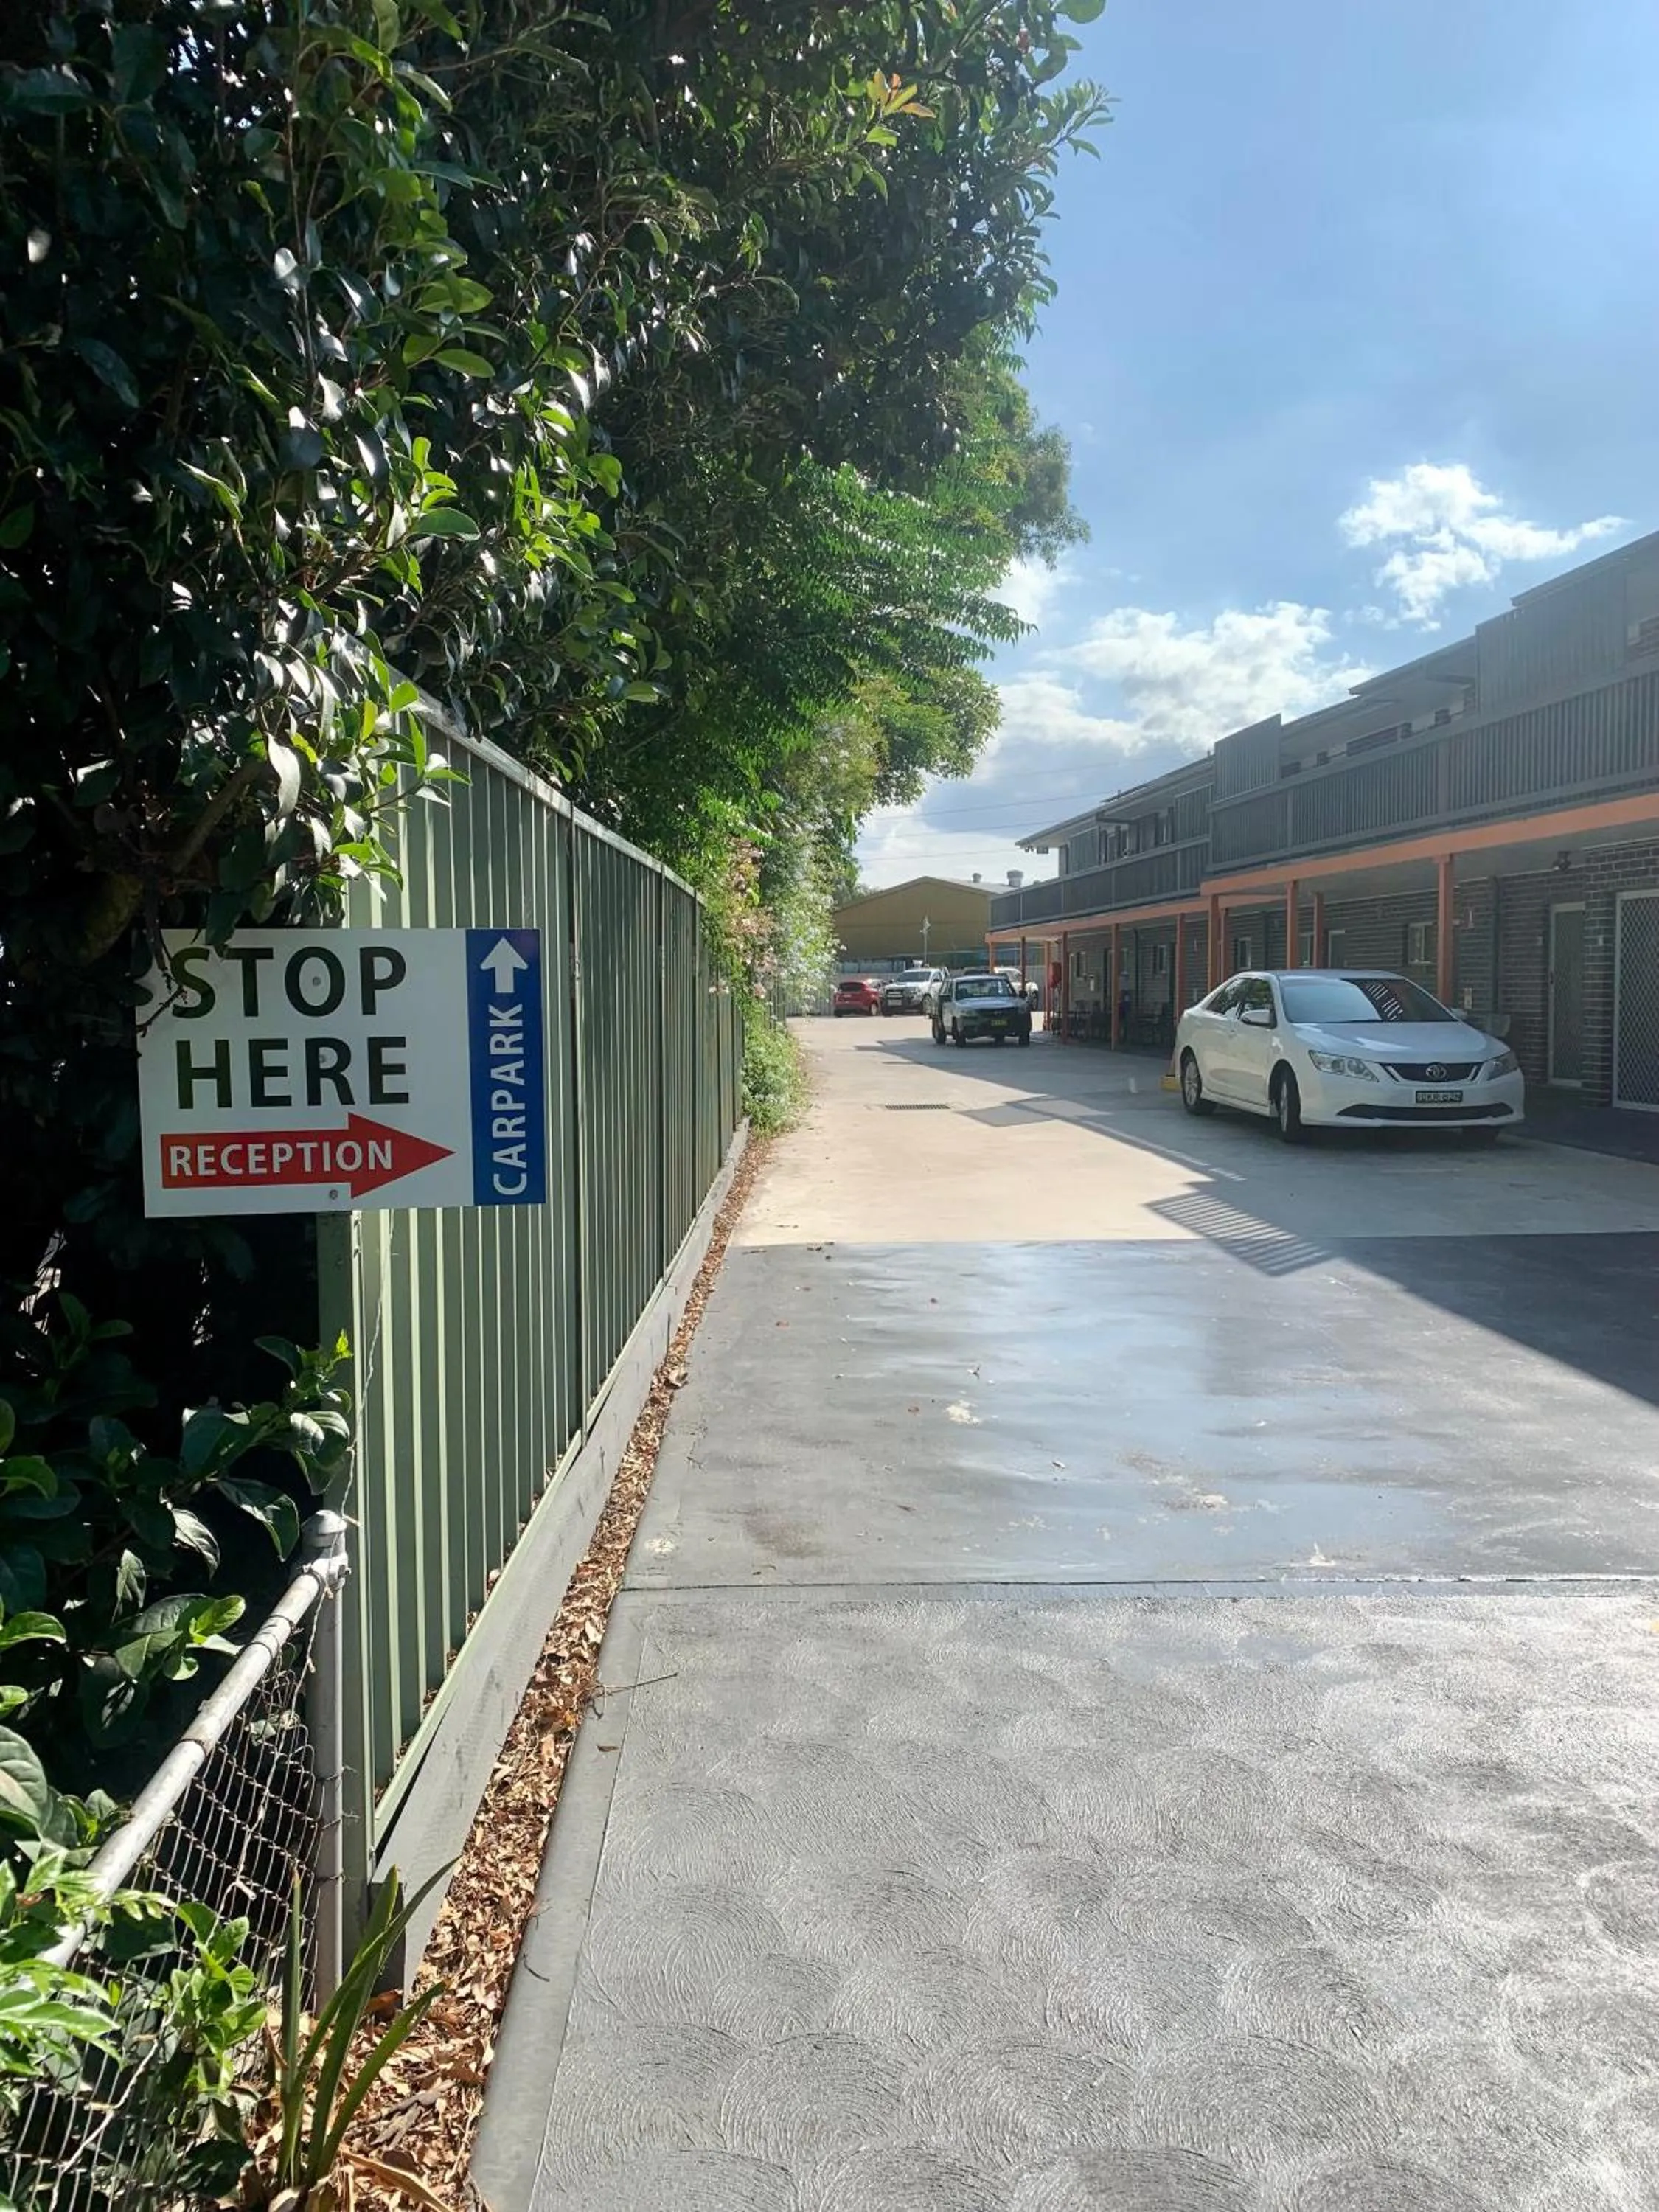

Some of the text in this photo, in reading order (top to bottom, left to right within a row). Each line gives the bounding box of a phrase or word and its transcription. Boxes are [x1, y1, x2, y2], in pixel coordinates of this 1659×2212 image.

[171, 945, 407, 1019] STOP
[175, 1035, 410, 1110] HERE
[487, 1002, 528, 1197] CARPARK
[168, 1139, 393, 1178] RECEPTION
